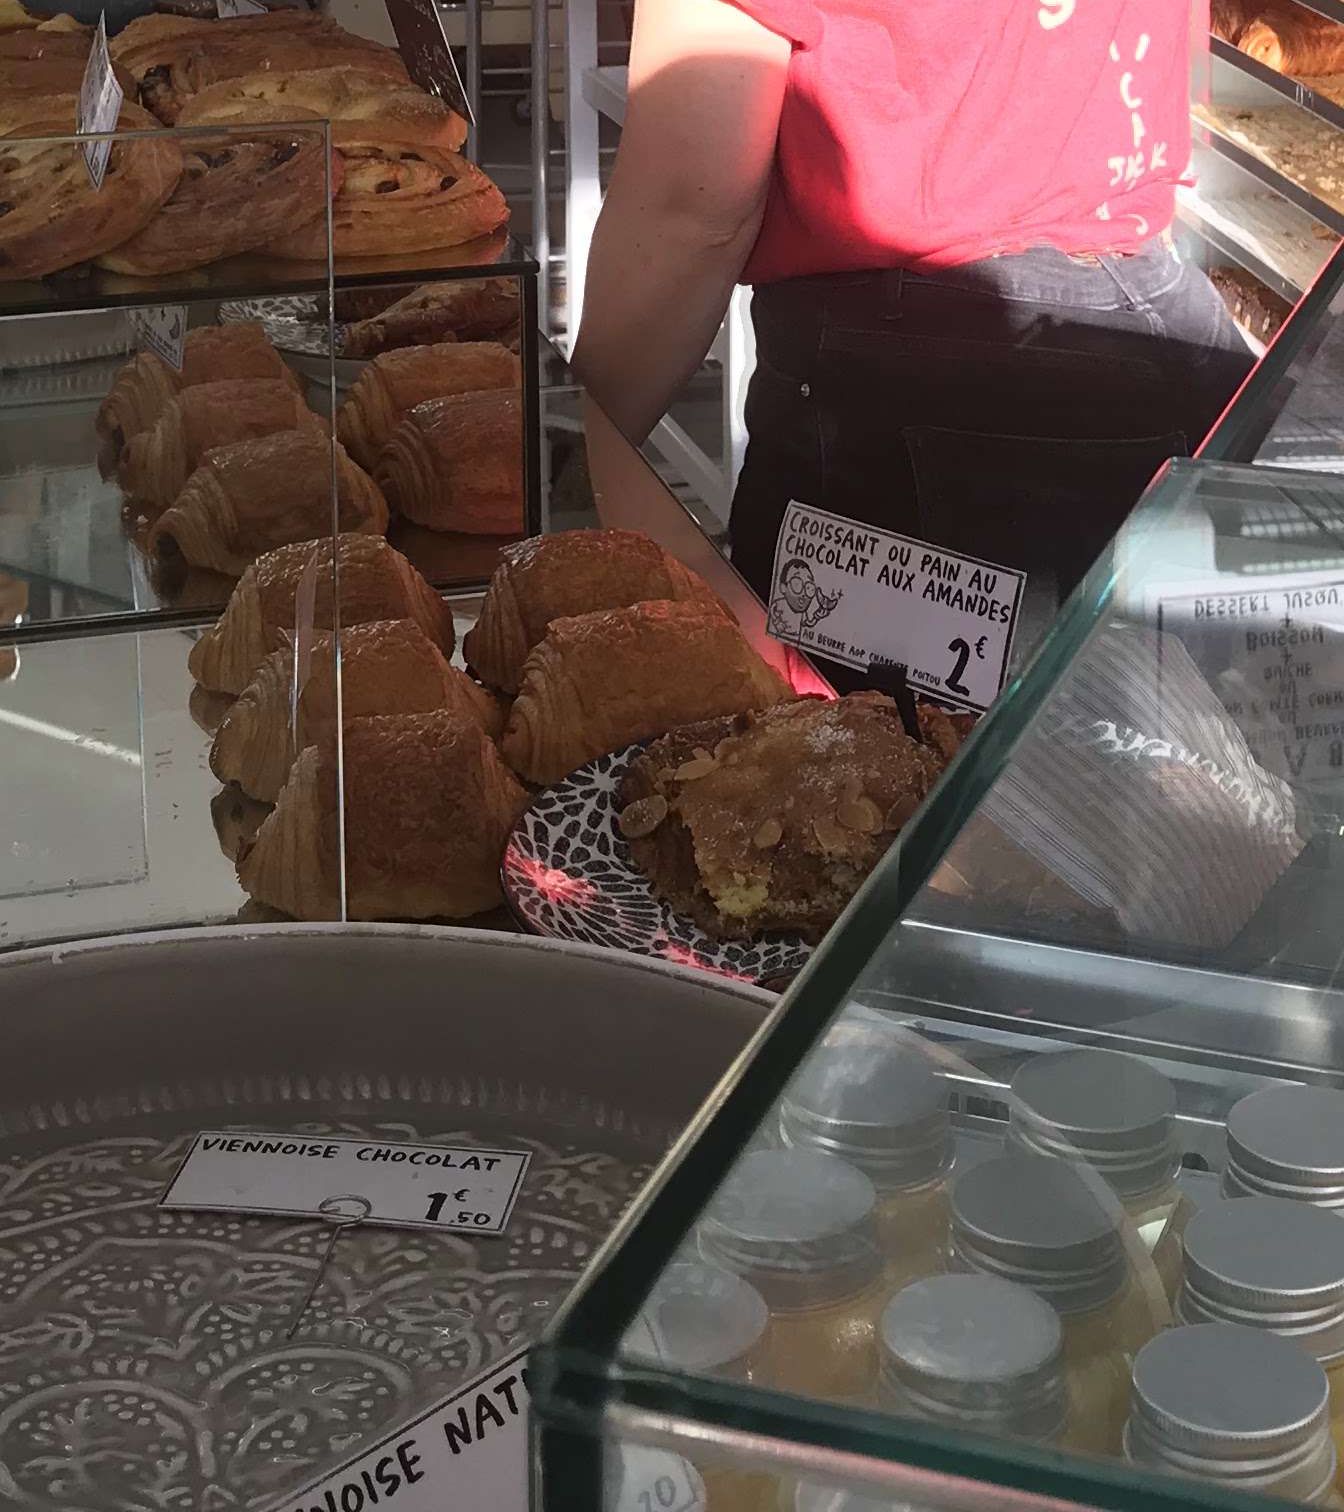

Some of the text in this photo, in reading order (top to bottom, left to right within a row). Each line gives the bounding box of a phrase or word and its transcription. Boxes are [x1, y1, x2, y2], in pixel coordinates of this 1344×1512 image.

[785, 534, 1011, 624] CHOCOLAT AUX AMANDES
[789, 510, 997, 595] CROISSANT OU PAIN AU
[803, 629, 815, 641] AU
[817, 633, 847, 653] BEURRE
[848, 645, 866, 658] AOP
[912, 668, 942, 687] POITOU
[201, 1138, 502, 1173] VIENNOISE CHOCOLAT
[295, 1368, 529, 1512] NOISE NAT
